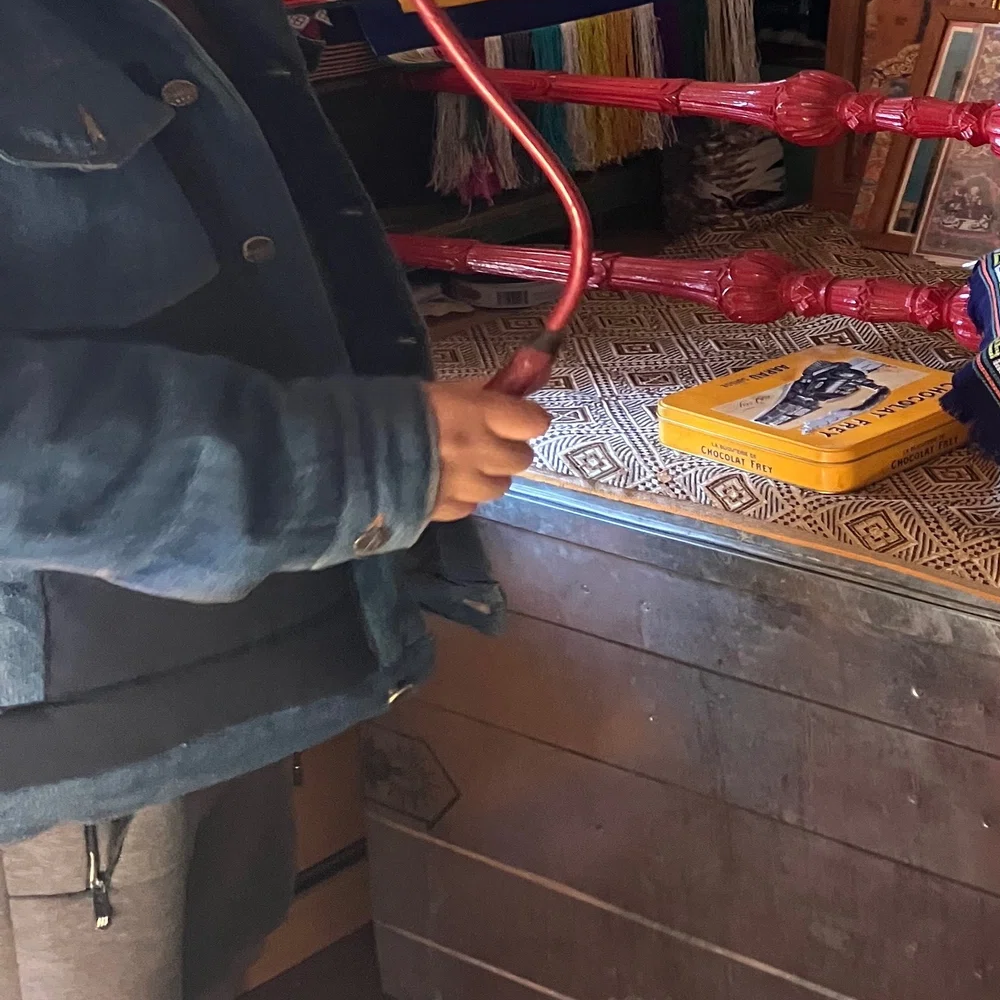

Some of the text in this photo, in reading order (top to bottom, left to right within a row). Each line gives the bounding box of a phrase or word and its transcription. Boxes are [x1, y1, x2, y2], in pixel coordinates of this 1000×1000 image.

[749, 364, 790, 381] AARAU
[819, 382, 953, 438] CHOCOLAT FREY
[701, 445, 773, 474] CHOCOLAT FREY
[891, 446, 934, 470] CHOCOLAT
